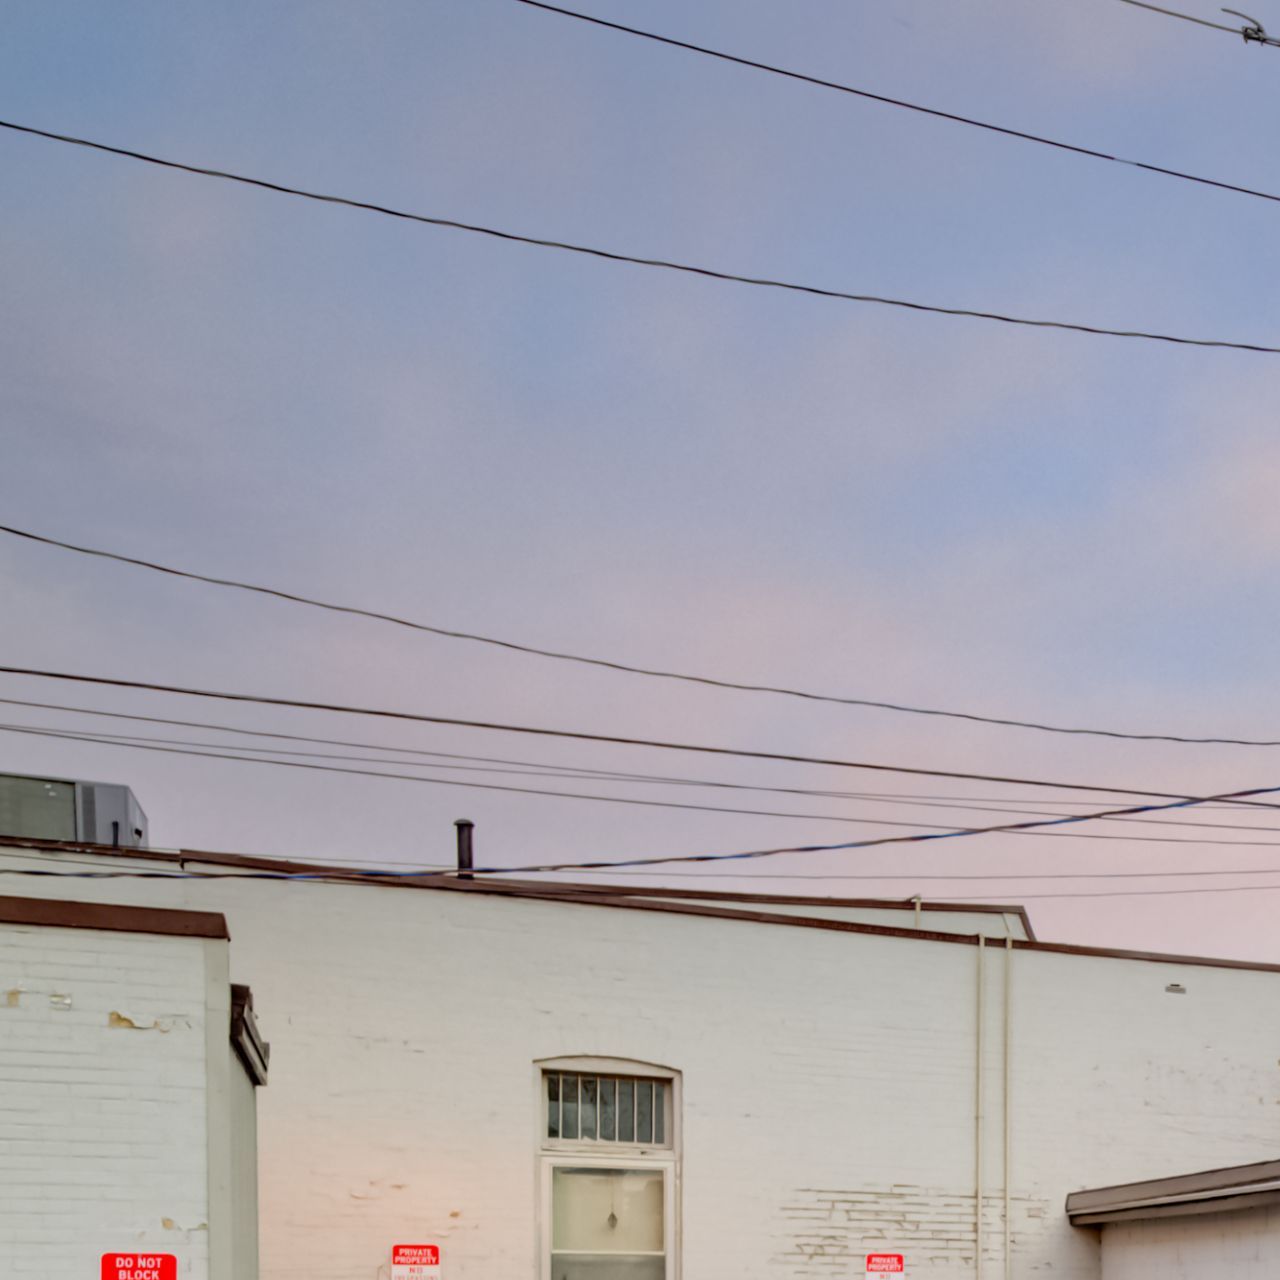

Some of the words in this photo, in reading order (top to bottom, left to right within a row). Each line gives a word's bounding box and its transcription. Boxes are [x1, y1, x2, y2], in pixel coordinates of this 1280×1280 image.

[399, 1248, 432, 1256] PRIVATE
[115, 1256, 134, 1269] DO
[137, 1256, 162, 1269] NOT
[394, 1256, 437, 1265] PROPERTY
[118, 1269, 160, 1280] BLOCK
